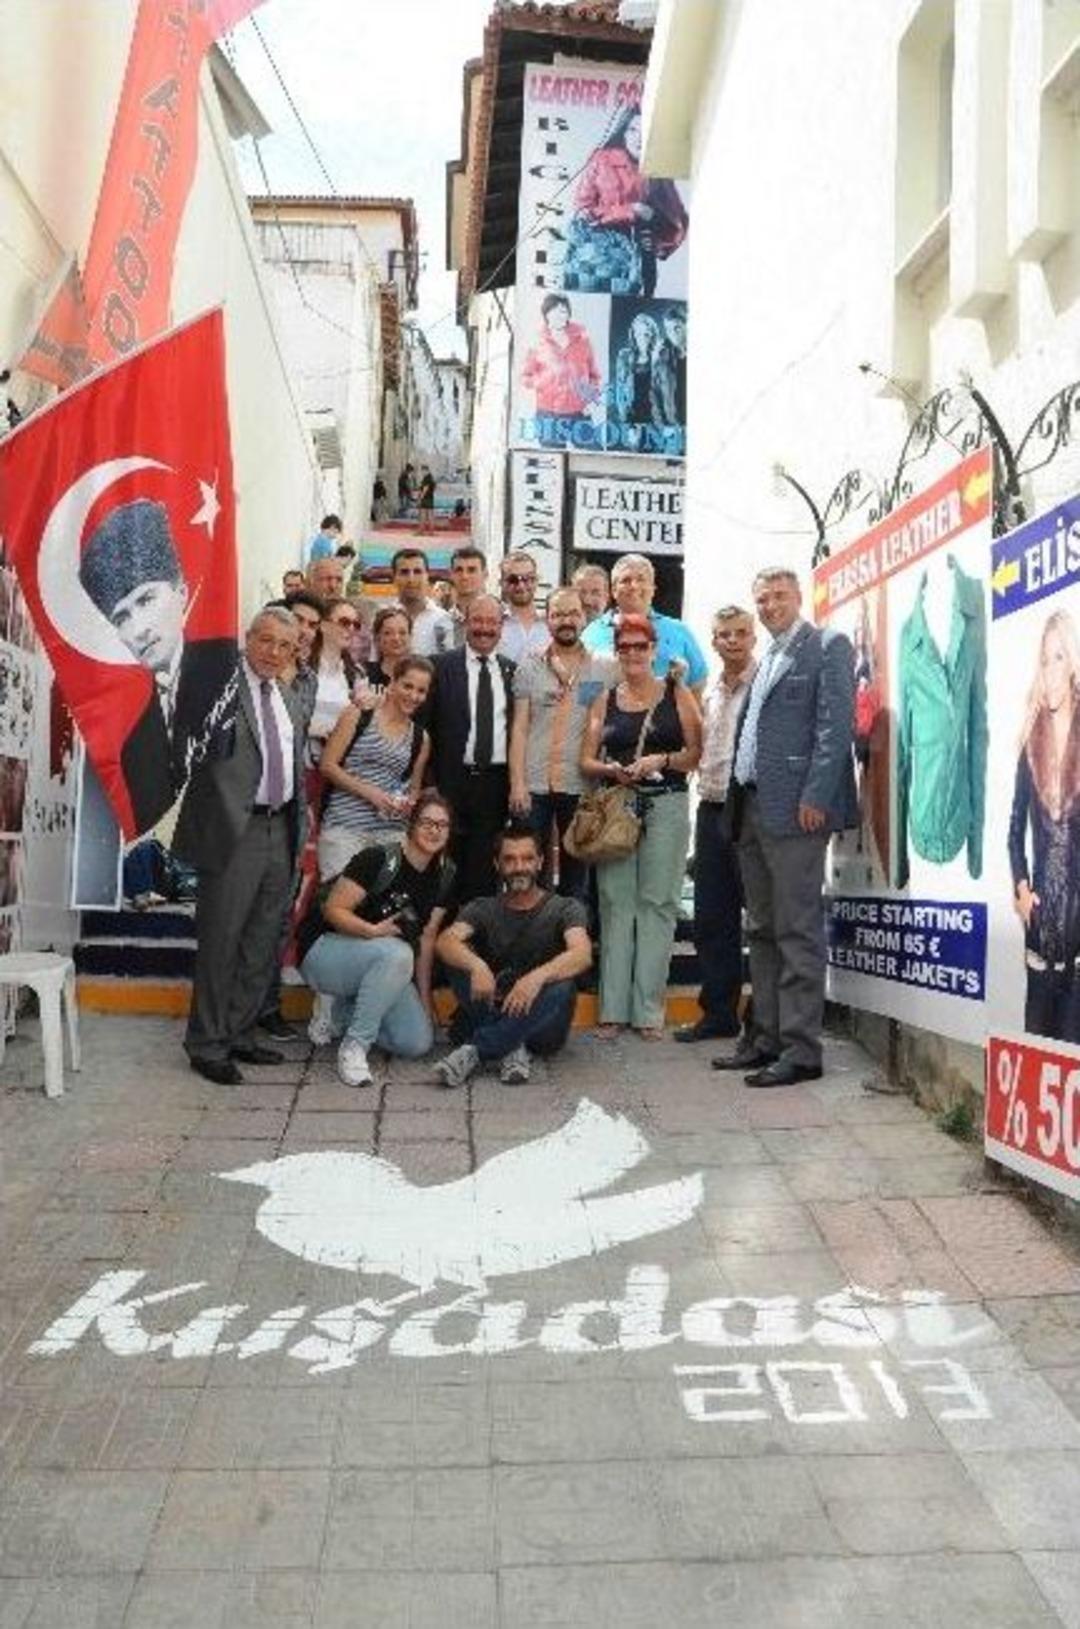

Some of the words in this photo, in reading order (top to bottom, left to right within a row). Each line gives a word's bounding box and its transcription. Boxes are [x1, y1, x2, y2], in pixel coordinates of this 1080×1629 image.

[530, 74, 610, 106] LEATHER
[882, 488, 962, 573] LEATHER
[830, 901, 878, 924] PRICE
[881, 903, 974, 933] STARTING
[855, 926, 900, 951] FROM
[826, 946, 898, 976] LEATHER
[673, 1359, 994, 1422] 2013
